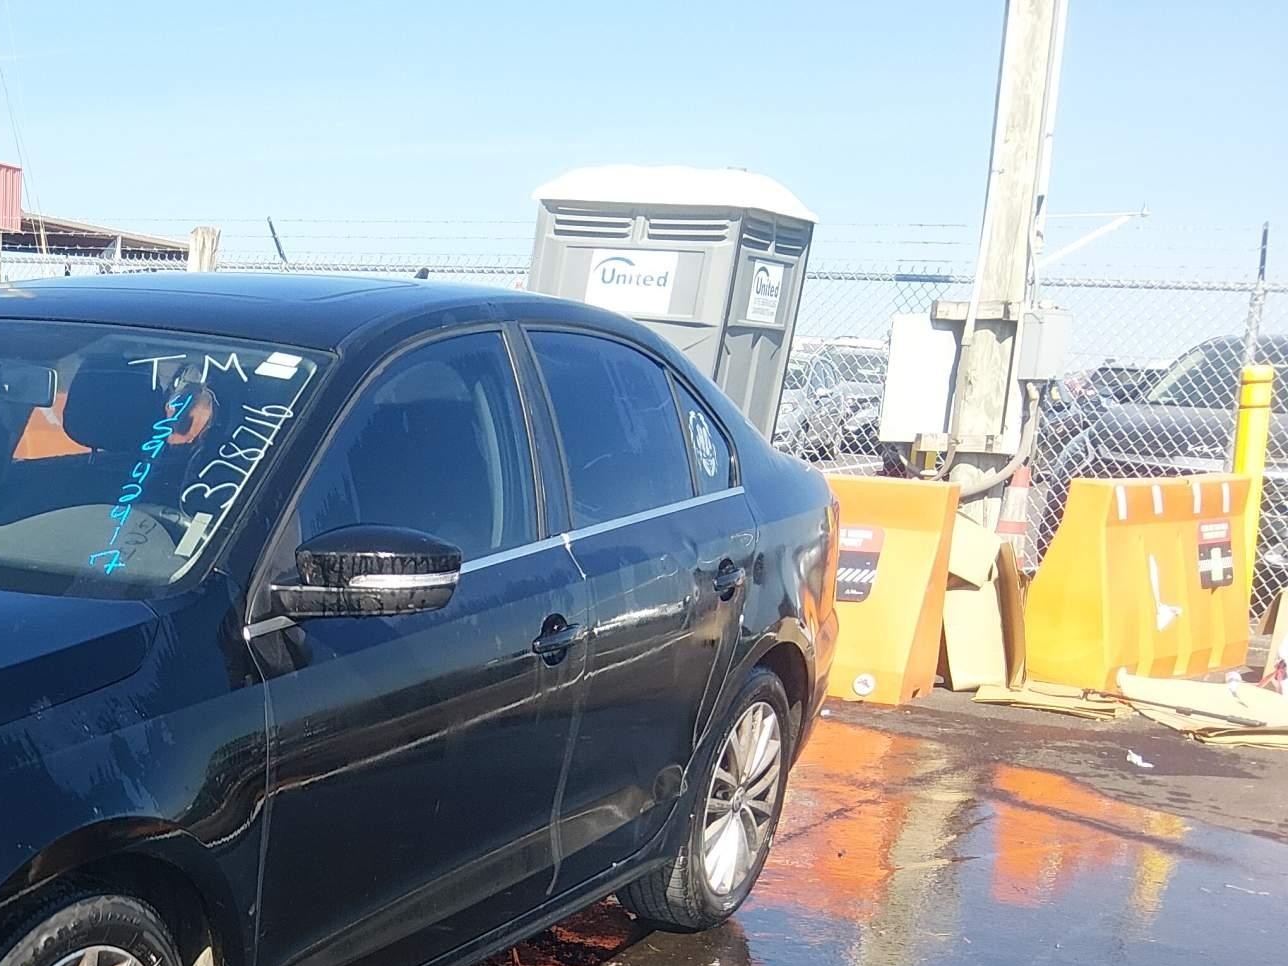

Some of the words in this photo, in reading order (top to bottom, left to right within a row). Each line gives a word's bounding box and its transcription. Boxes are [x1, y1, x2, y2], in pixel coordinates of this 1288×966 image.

[601, 267, 669, 287] United
[755, 276, 781, 298] United
[88, 393, 193, 576] 45942417
